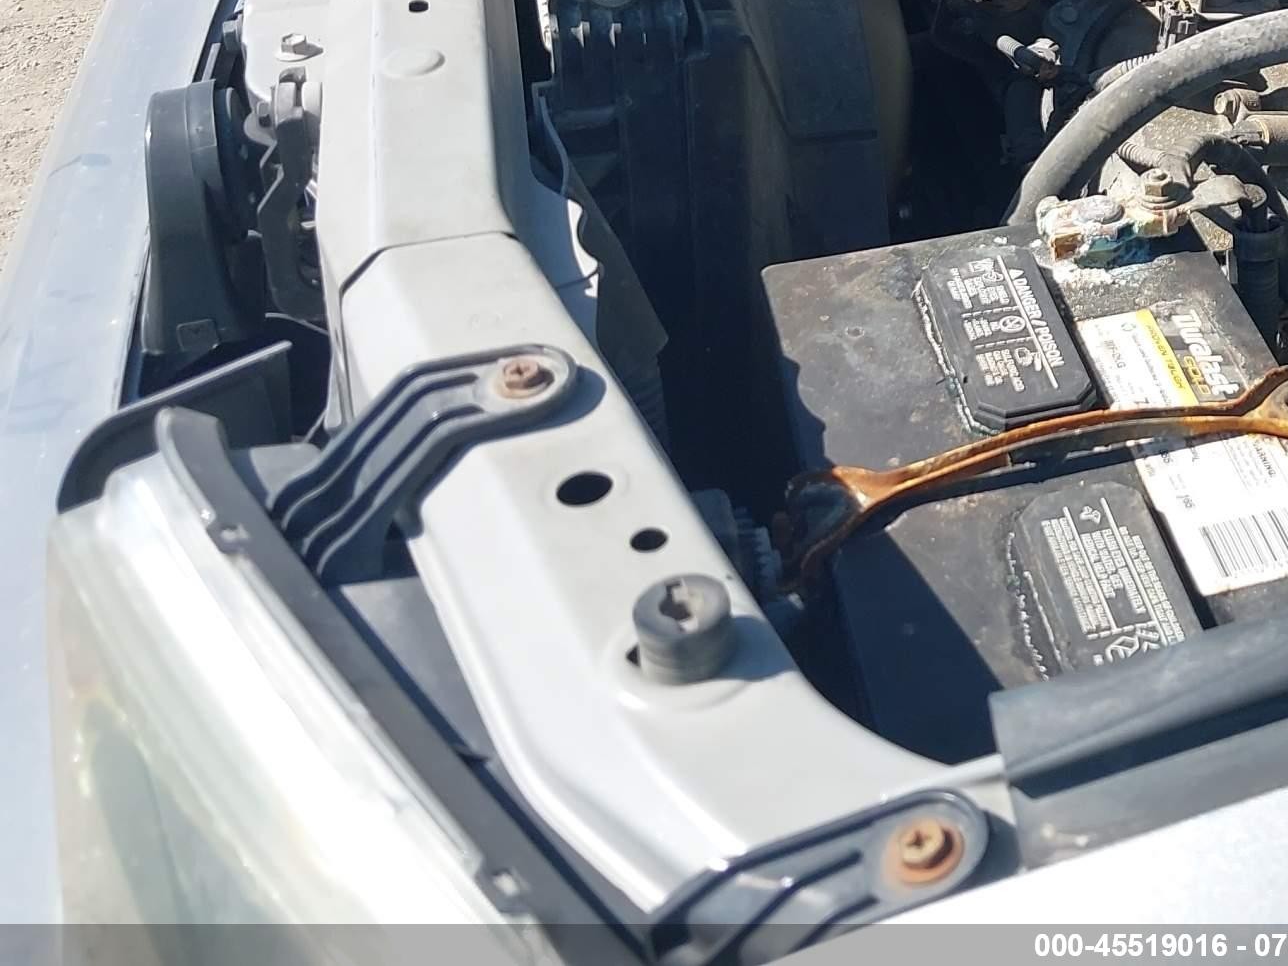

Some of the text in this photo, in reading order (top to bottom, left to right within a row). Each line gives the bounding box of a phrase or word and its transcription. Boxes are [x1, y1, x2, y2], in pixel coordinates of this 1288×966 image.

[1012, 278, 1043, 320] DANGER
[1034, 326, 1065, 368] POISON
[1171, 309, 1240, 396] Duralast
[1184, 356, 1212, 395] GOLD
